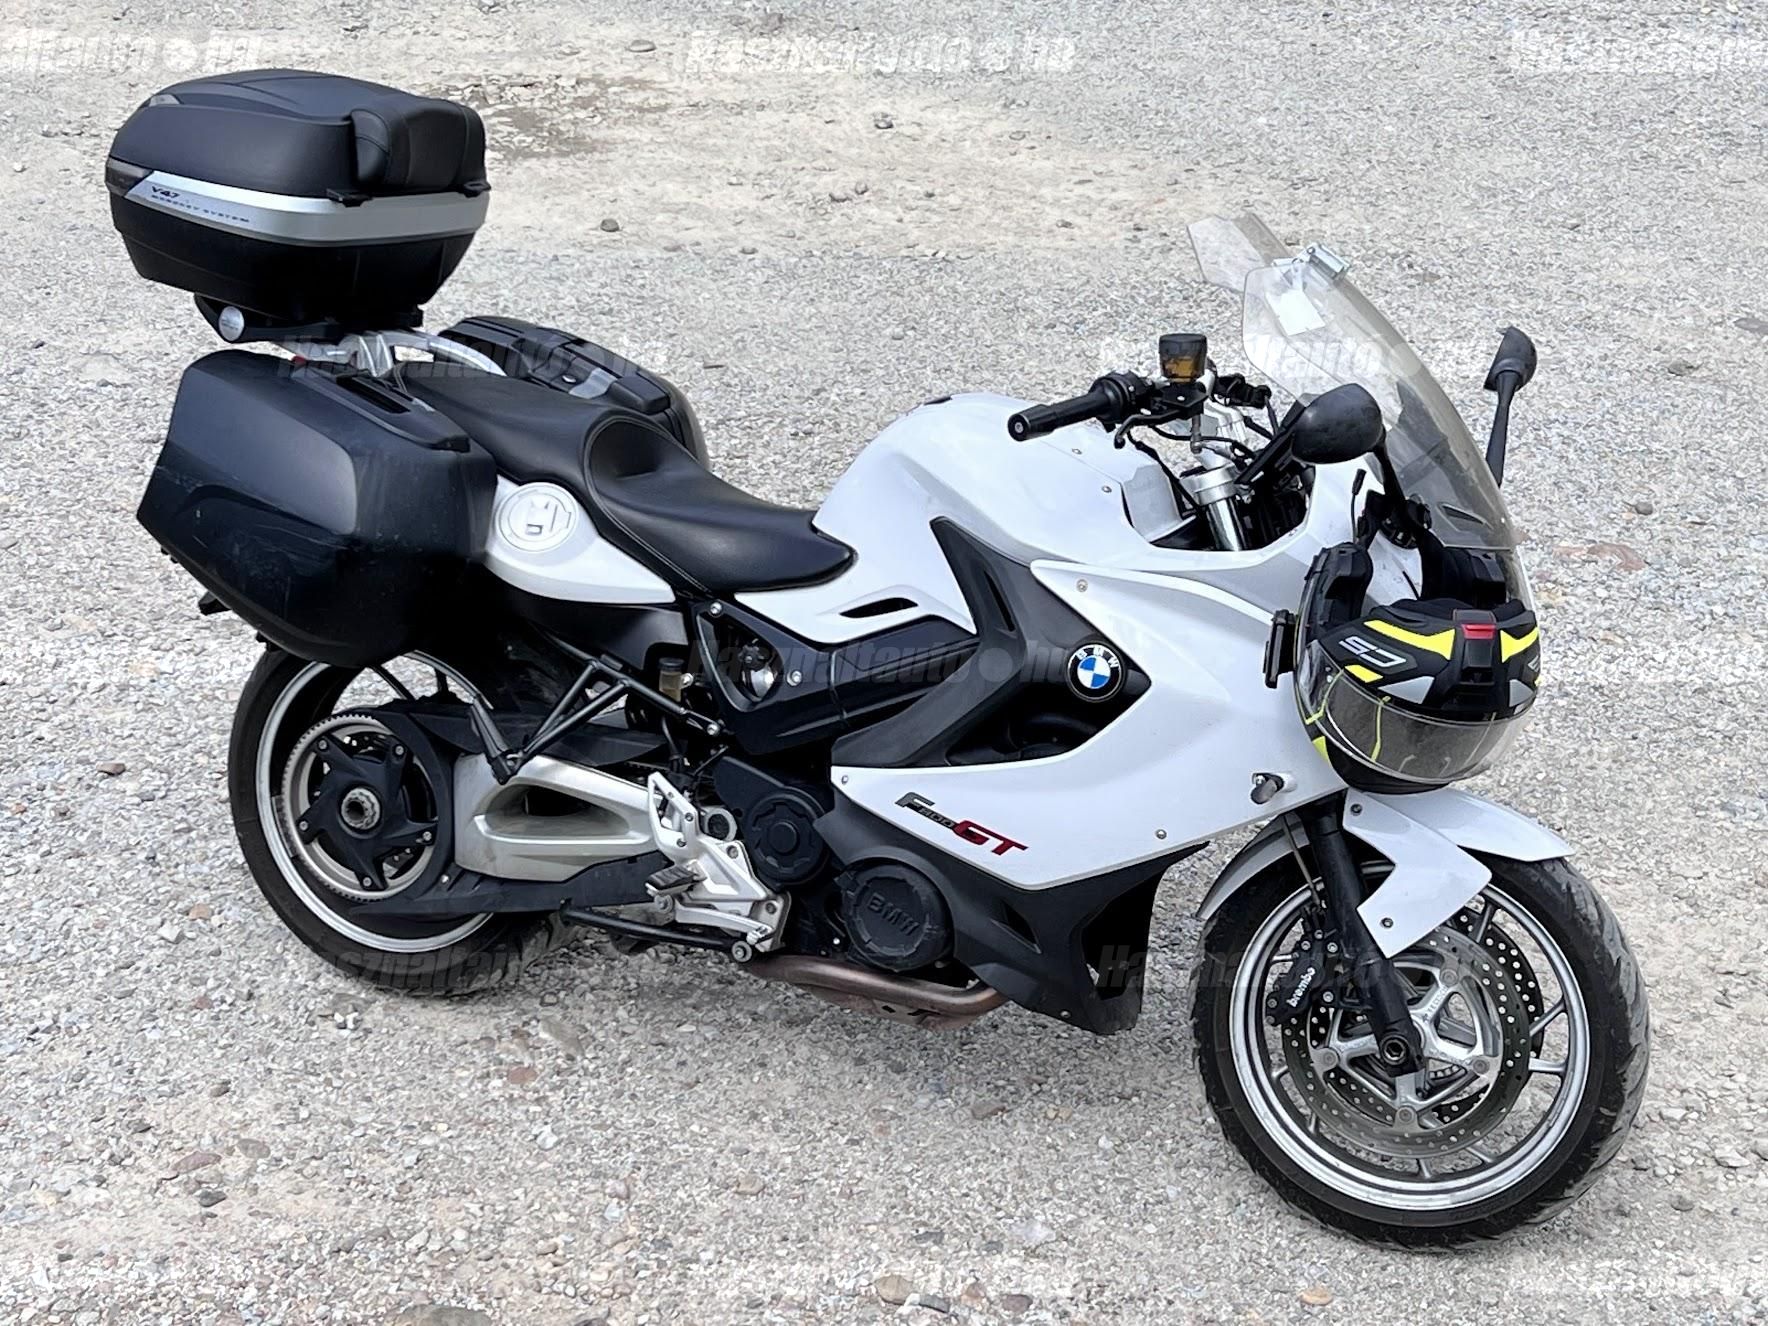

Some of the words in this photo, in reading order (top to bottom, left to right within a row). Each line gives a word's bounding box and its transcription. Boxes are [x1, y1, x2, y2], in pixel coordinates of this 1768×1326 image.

[151, 186, 181, 199] V47
[203, 209, 250, 222] SYSTEM
[867, 892, 920, 936] BMW
[1286, 966, 1317, 1008] brembo
